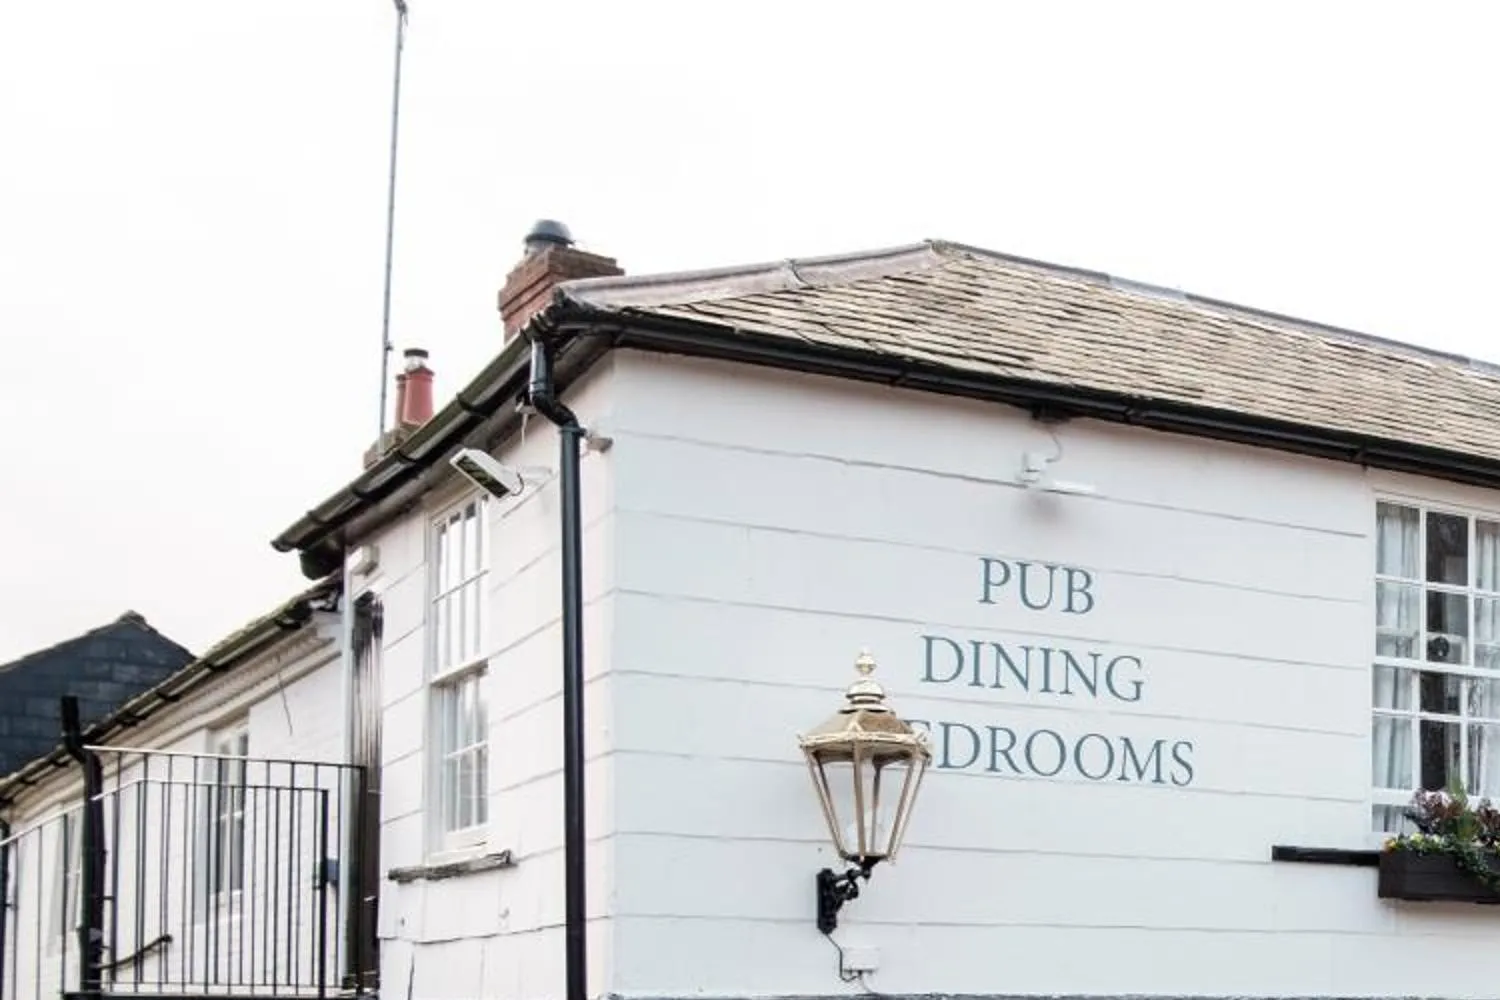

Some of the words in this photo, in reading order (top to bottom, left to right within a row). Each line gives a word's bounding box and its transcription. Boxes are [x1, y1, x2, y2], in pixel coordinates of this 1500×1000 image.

[977, 556, 1095, 615] PUB
[920, 634, 1145, 702] DINING
[902, 718, 1195, 787] DROOMS
